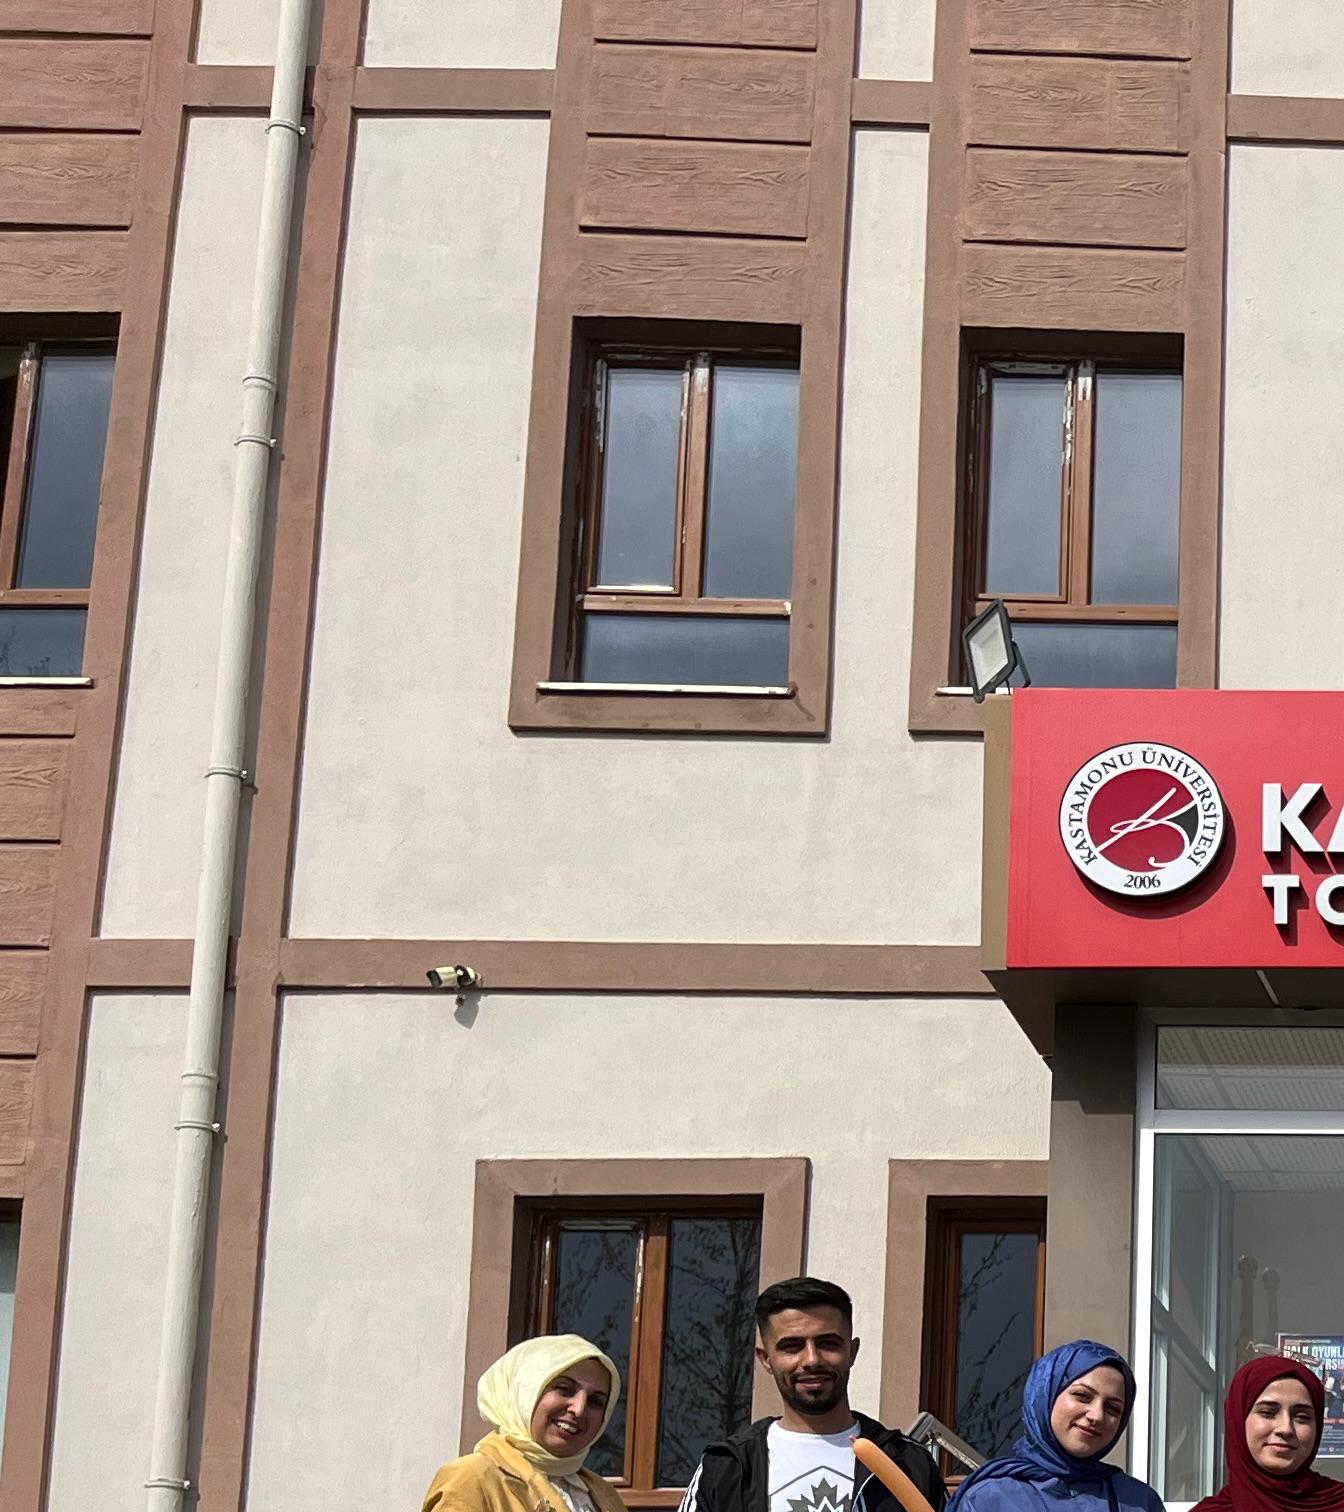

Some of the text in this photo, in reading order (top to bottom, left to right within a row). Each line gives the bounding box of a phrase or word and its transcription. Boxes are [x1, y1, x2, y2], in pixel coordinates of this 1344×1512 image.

[1069, 747, 1220, 867] KASTAMONU ÜNİVERSİTESİ
[1123, 873, 1161, 889] 2006
